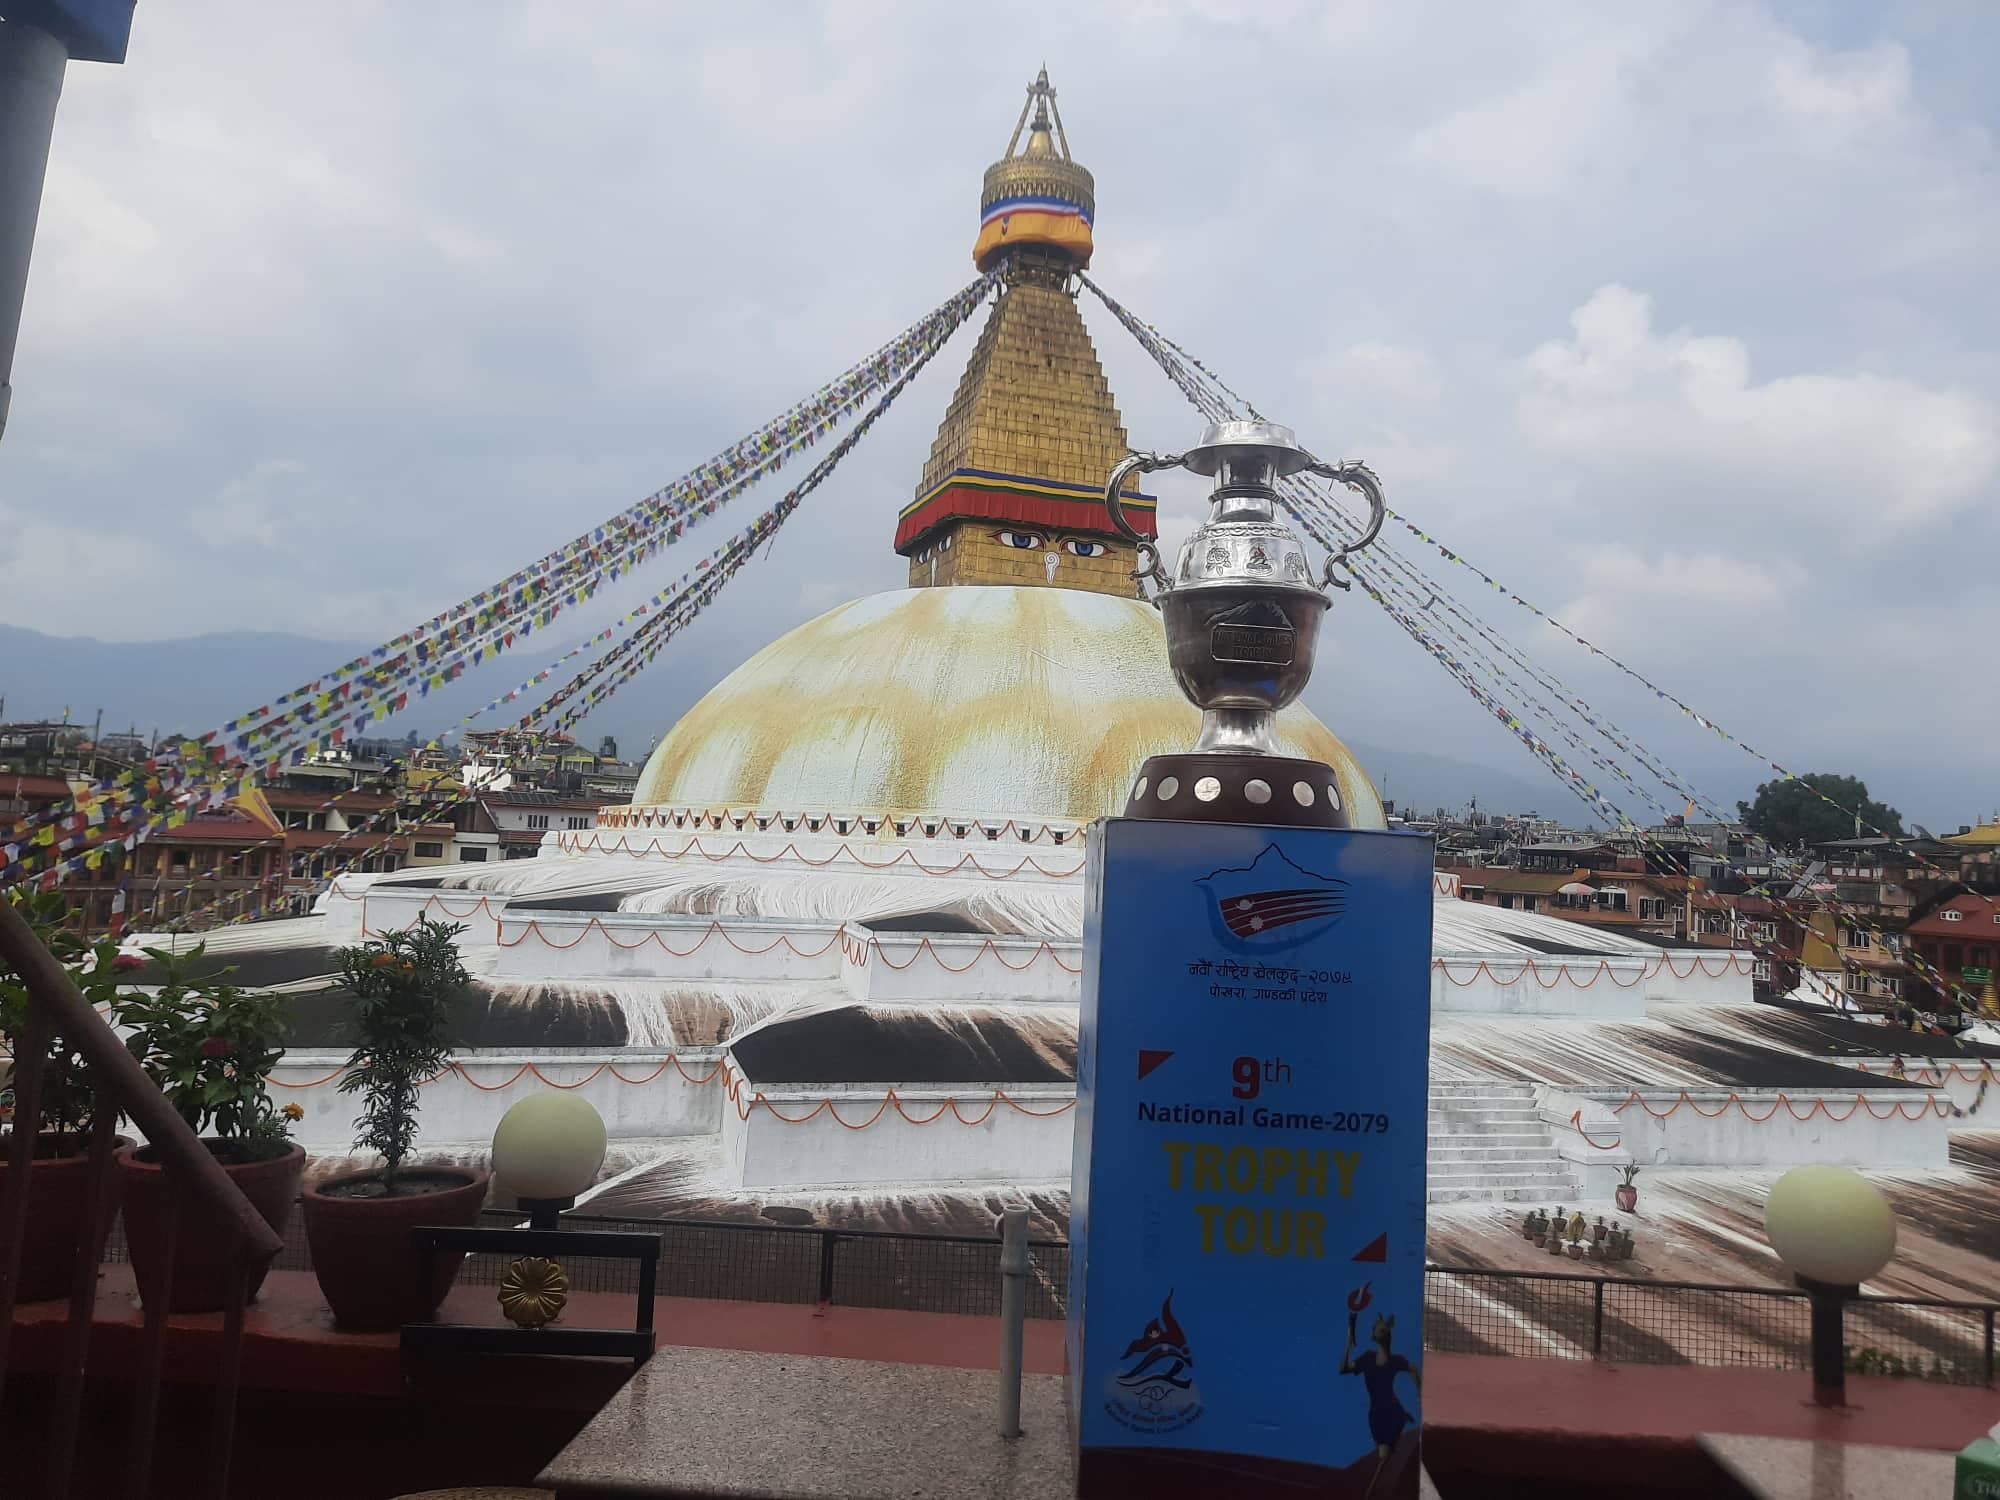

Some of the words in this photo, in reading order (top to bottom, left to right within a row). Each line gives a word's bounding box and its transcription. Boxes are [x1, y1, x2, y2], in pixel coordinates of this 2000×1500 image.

[1232, 1056, 1291, 1099] 9th
[1138, 1102, 1244, 1126] National
[1252, 1107, 1390, 1134] Game-2079
[1161, 1141, 1362, 1198] TROPHY
[1193, 1203, 1326, 1258] TOUR
